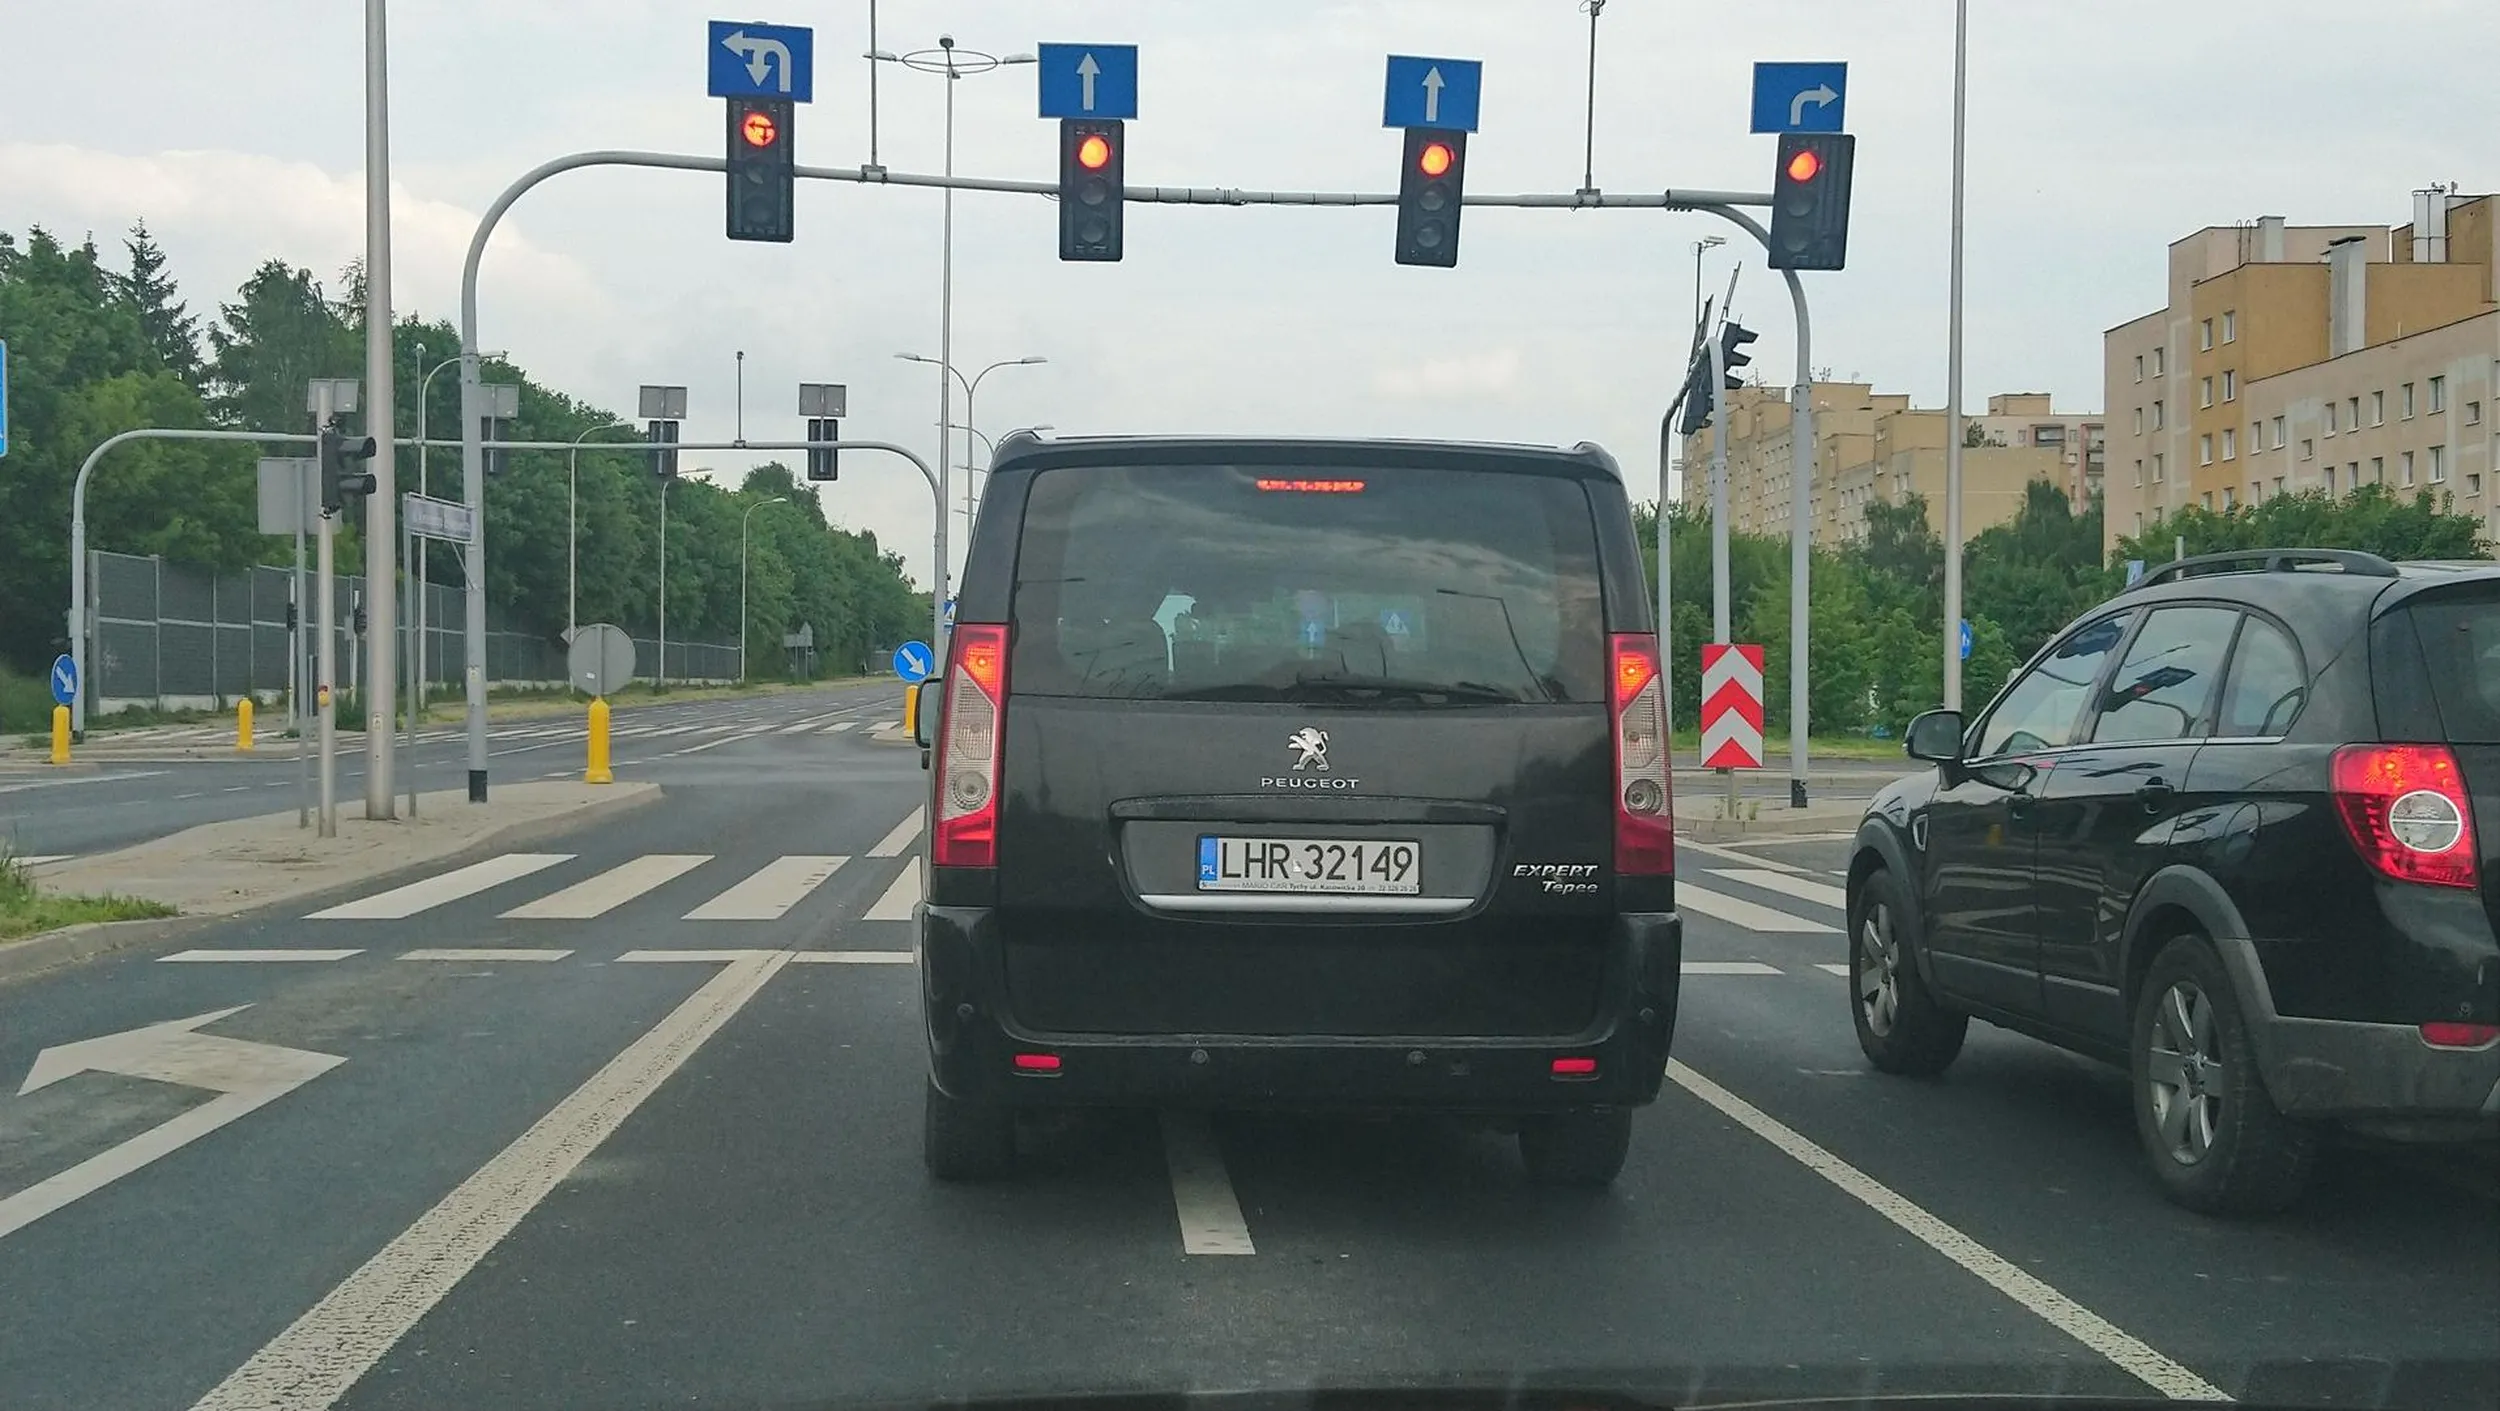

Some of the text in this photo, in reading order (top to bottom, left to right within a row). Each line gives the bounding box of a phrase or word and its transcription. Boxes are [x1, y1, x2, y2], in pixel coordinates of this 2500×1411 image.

[1261, 777, 1359, 789] PEUGEOT
[1222, 842, 1413, 882] LHR 32149
[1202, 864, 1215, 875] PL
[1513, 864, 1598, 877] EXPERT
[1542, 880, 1598, 895] Tepee
